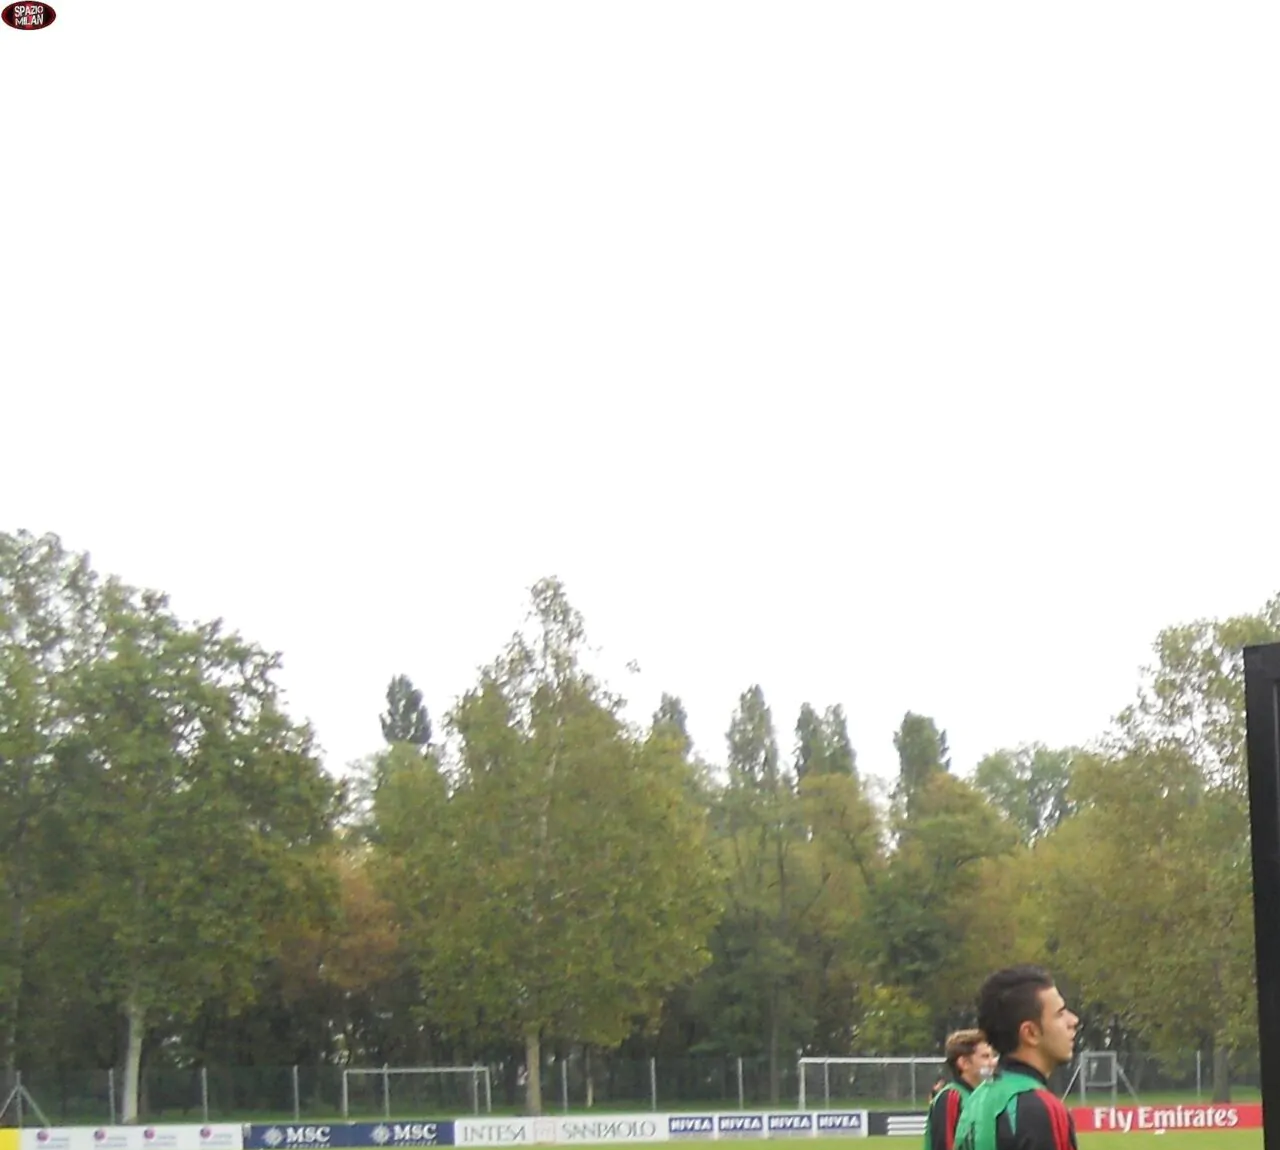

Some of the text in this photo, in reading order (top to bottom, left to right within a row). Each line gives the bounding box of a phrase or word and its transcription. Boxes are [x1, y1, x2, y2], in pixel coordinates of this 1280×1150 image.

[671, 1119, 712, 1132] NIVEA
[721, 1118, 762, 1131] NIVEA
[770, 1116, 812, 1129] NIVEA
[820, 1115, 859, 1128] NIVEA
[1094, 1105, 1238, 1133] Fly Emirates
[286, 1126, 331, 1143] MSC
[393, 1123, 437, 1140] MSC
[463, 1120, 657, 1142] INTESA SANPAOLO
